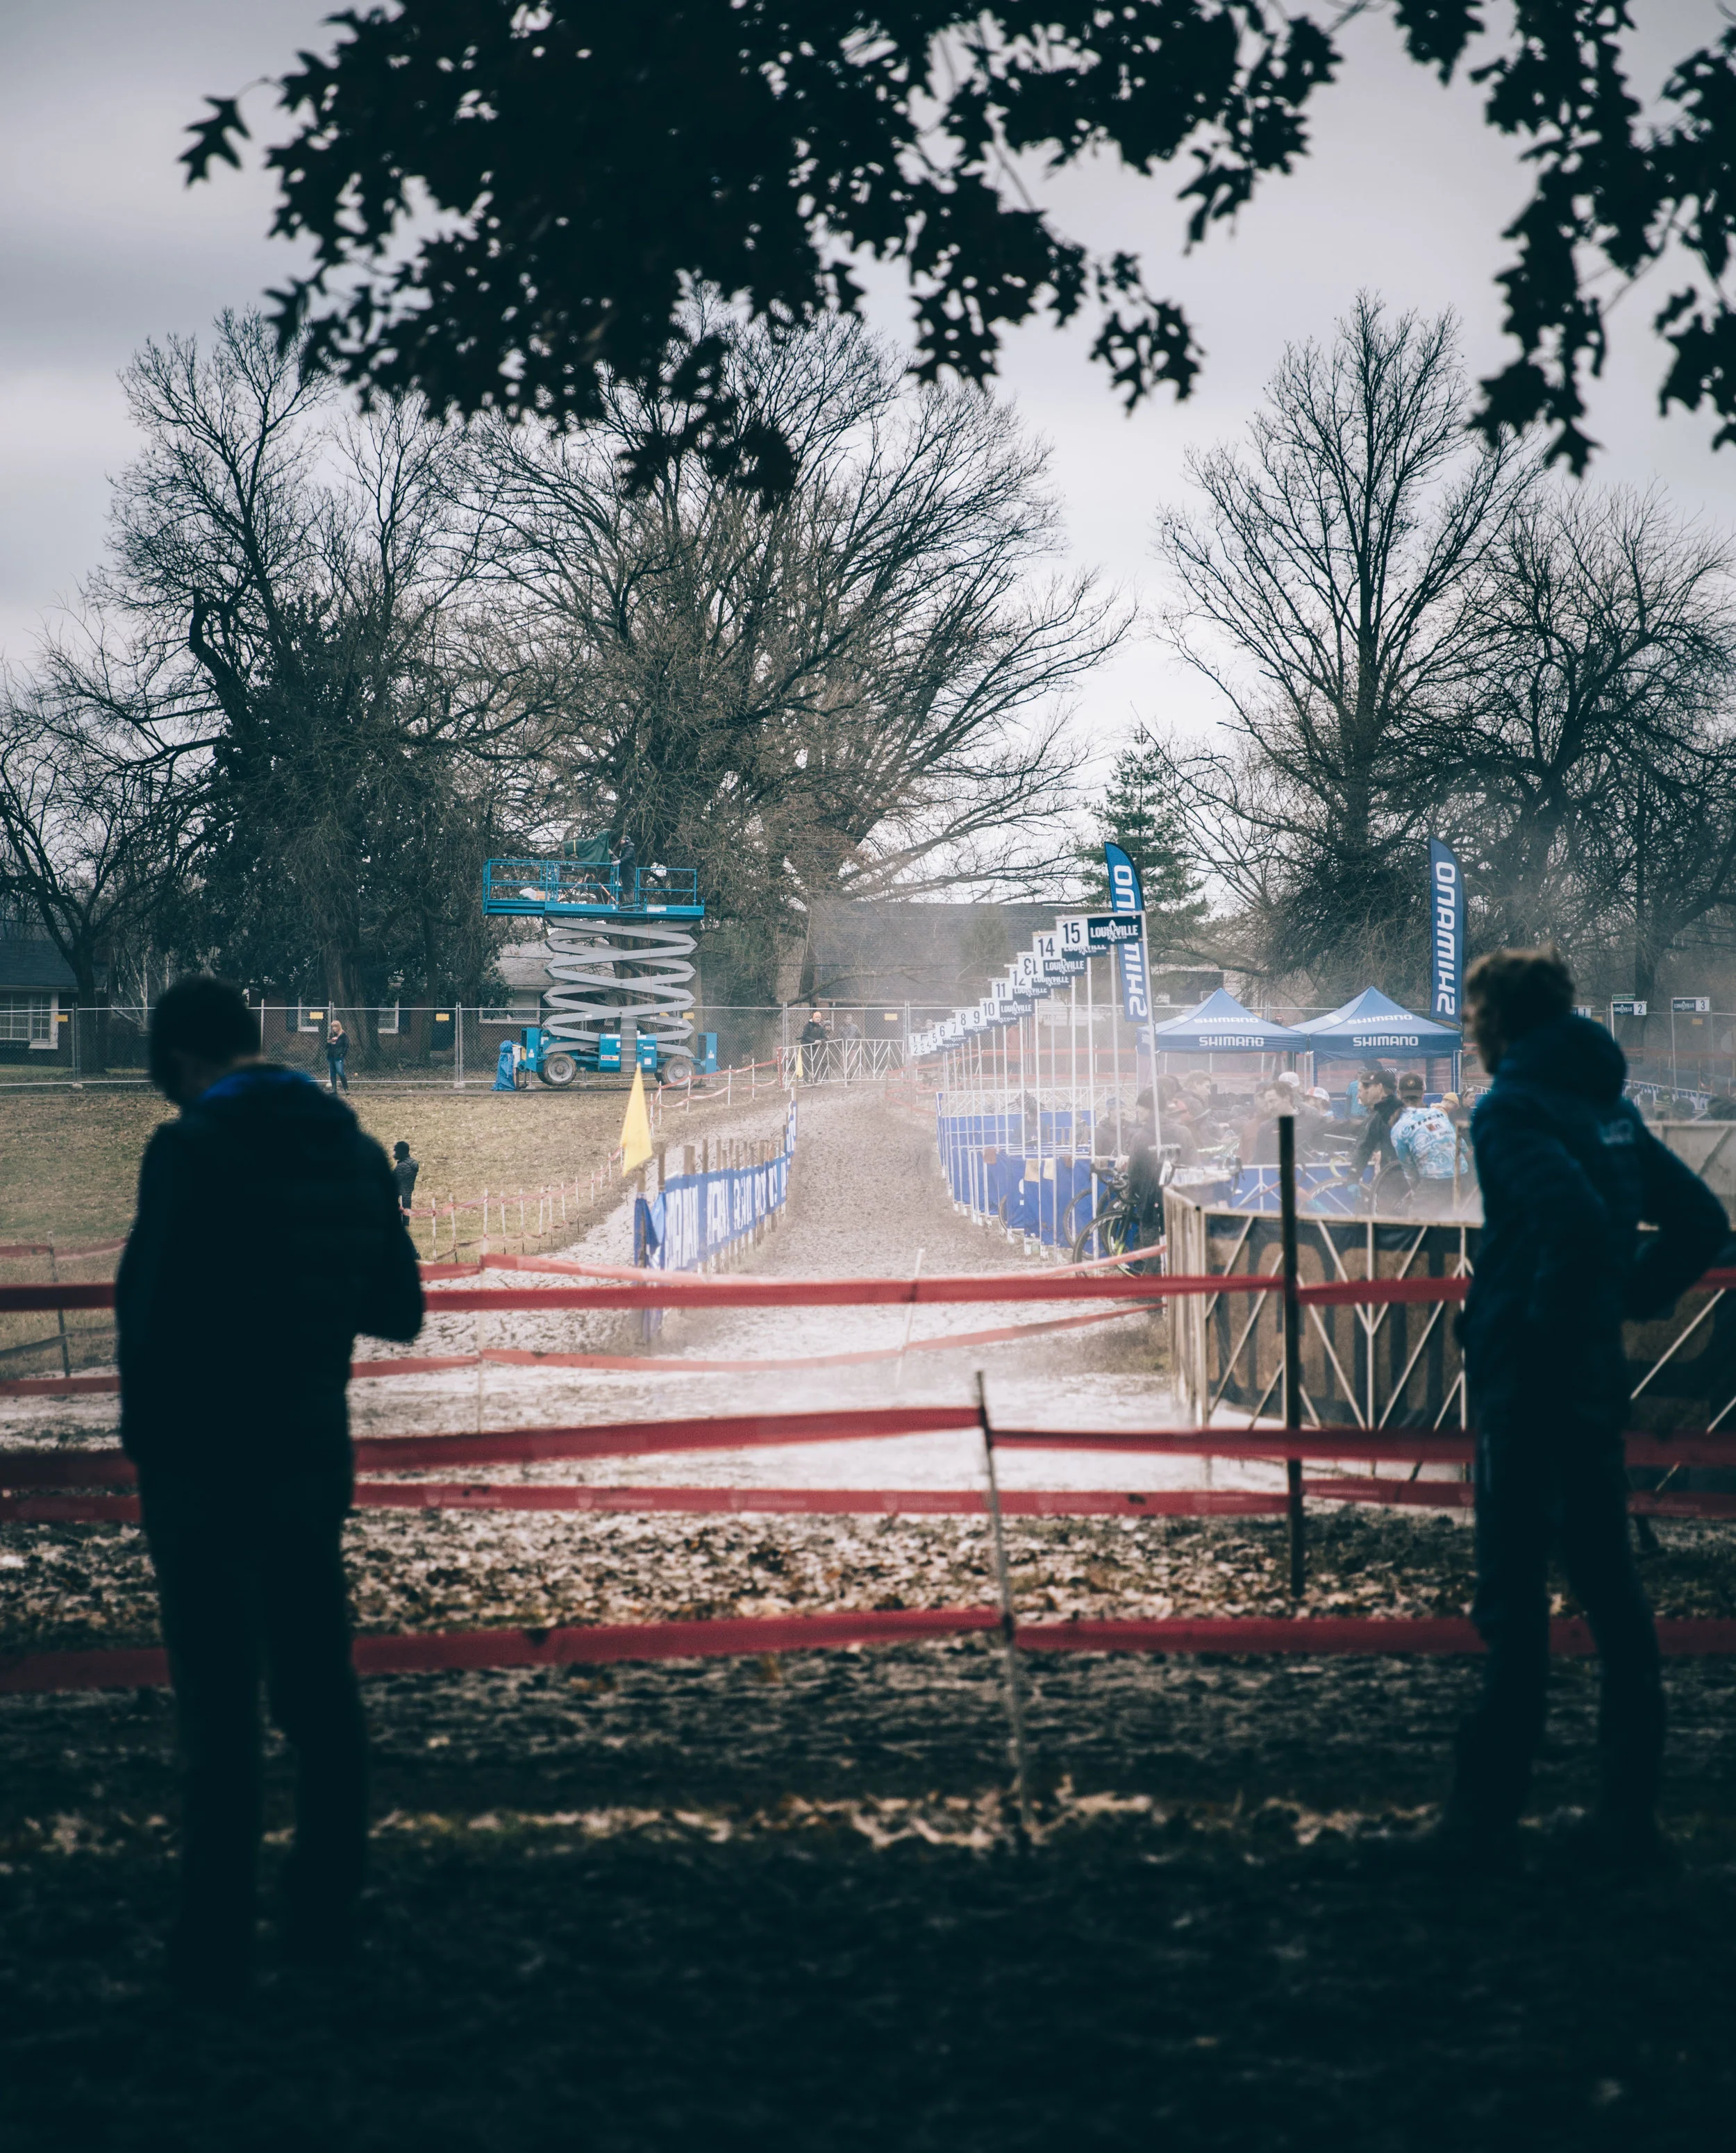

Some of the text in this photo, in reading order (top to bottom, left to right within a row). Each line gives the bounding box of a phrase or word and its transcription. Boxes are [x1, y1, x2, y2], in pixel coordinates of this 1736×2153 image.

[1062, 923, 1080, 944] 15
[1037, 937, 1055, 957] 14
[1024, 957, 1038, 975] 13
[995, 982, 1005, 998] 11
[983, 1002, 995, 1016] 10
[1637, 1004, 1643, 1014] 2
[1700, 1000, 1705, 1010] 3
[974, 1011, 980, 1024] 9
[1583, 1008, 1586, 1017] 1
[960, 1013, 966, 1025] 8
[1347, 1014, 1413, 1025] SHIMANO
[940, 1025, 945, 1037] 6
[951, 1022, 956, 1034] 7
[932, 1032, 937, 1044] 5
[1199, 1036, 1265, 1047] SHIMANO
[1353, 1036, 1419, 1047] SHIMANO
[913, 1044, 918, 1054] 2
